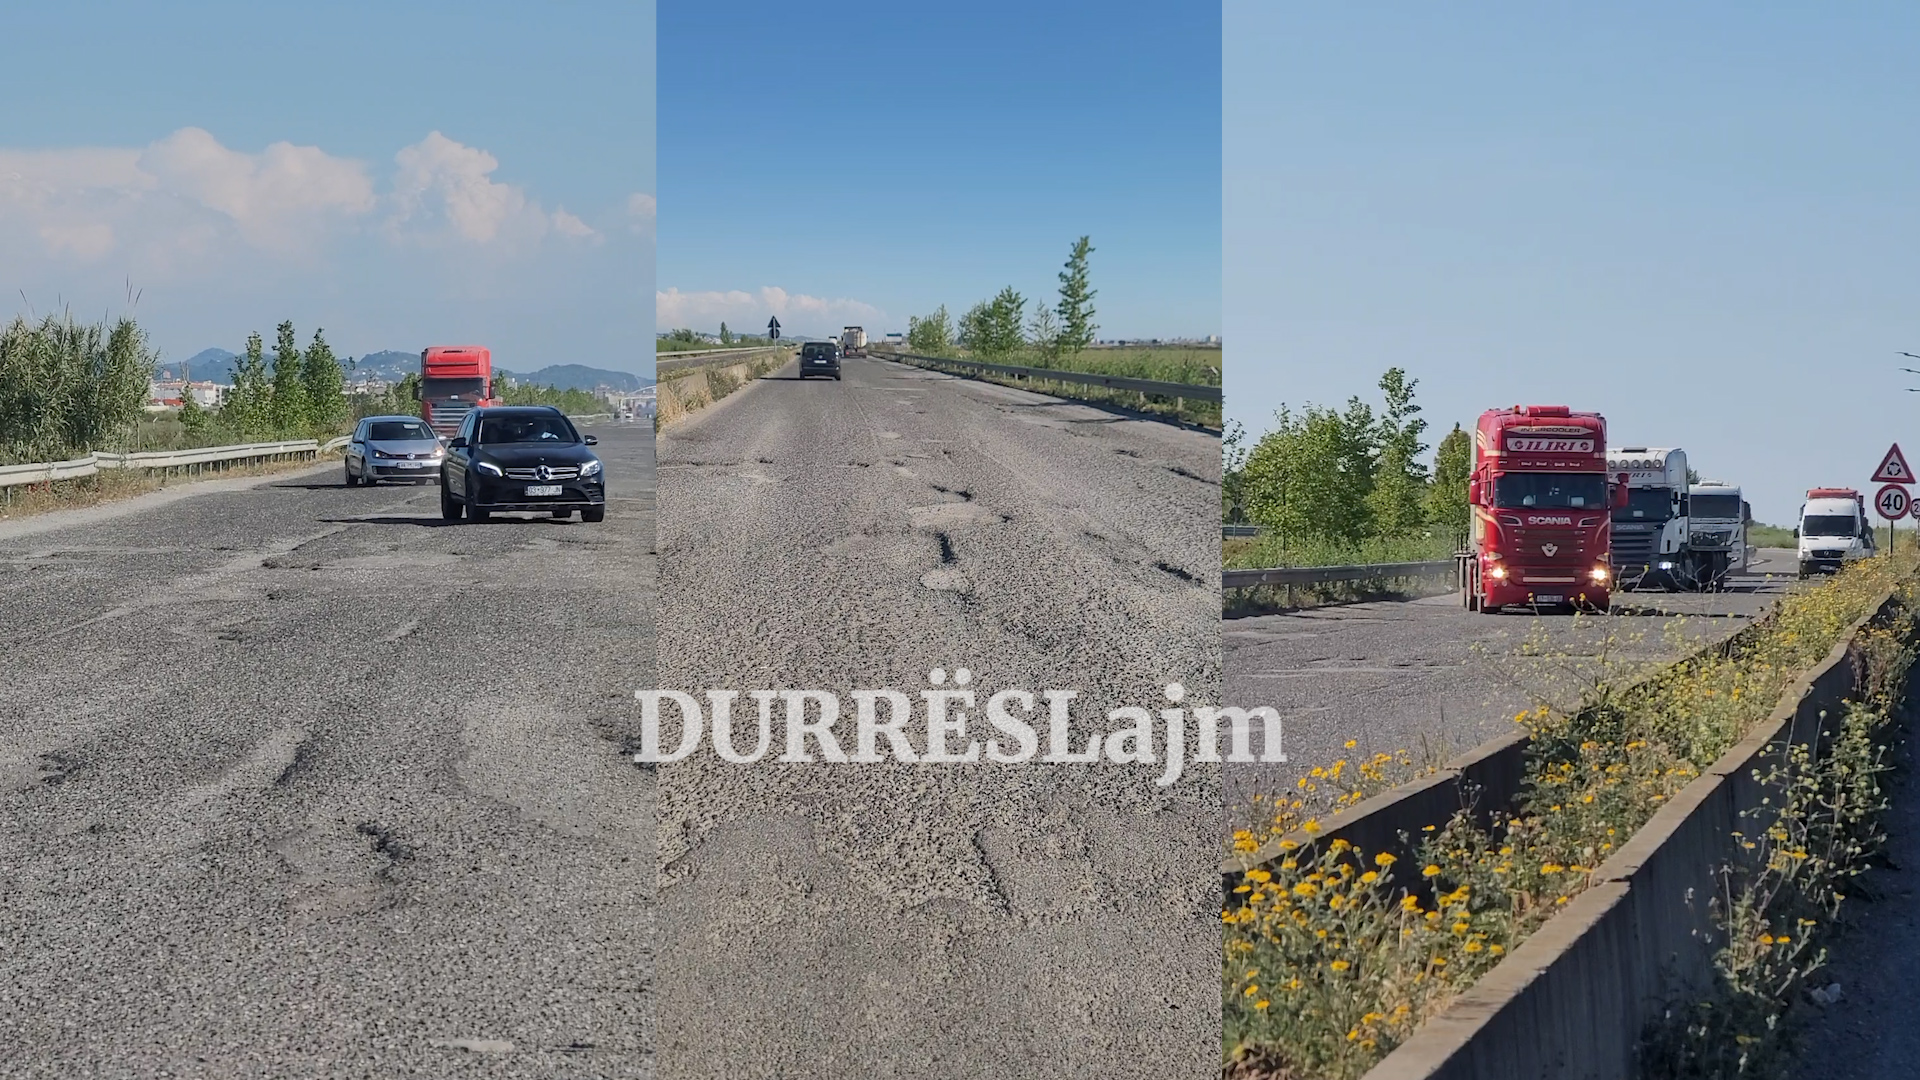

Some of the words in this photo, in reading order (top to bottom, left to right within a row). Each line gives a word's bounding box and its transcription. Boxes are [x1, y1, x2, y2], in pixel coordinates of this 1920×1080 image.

[1525, 441, 1577, 451] ILIRI
[1881, 493, 1903, 511] 40
[1528, 516, 1572, 526] SCANIA
